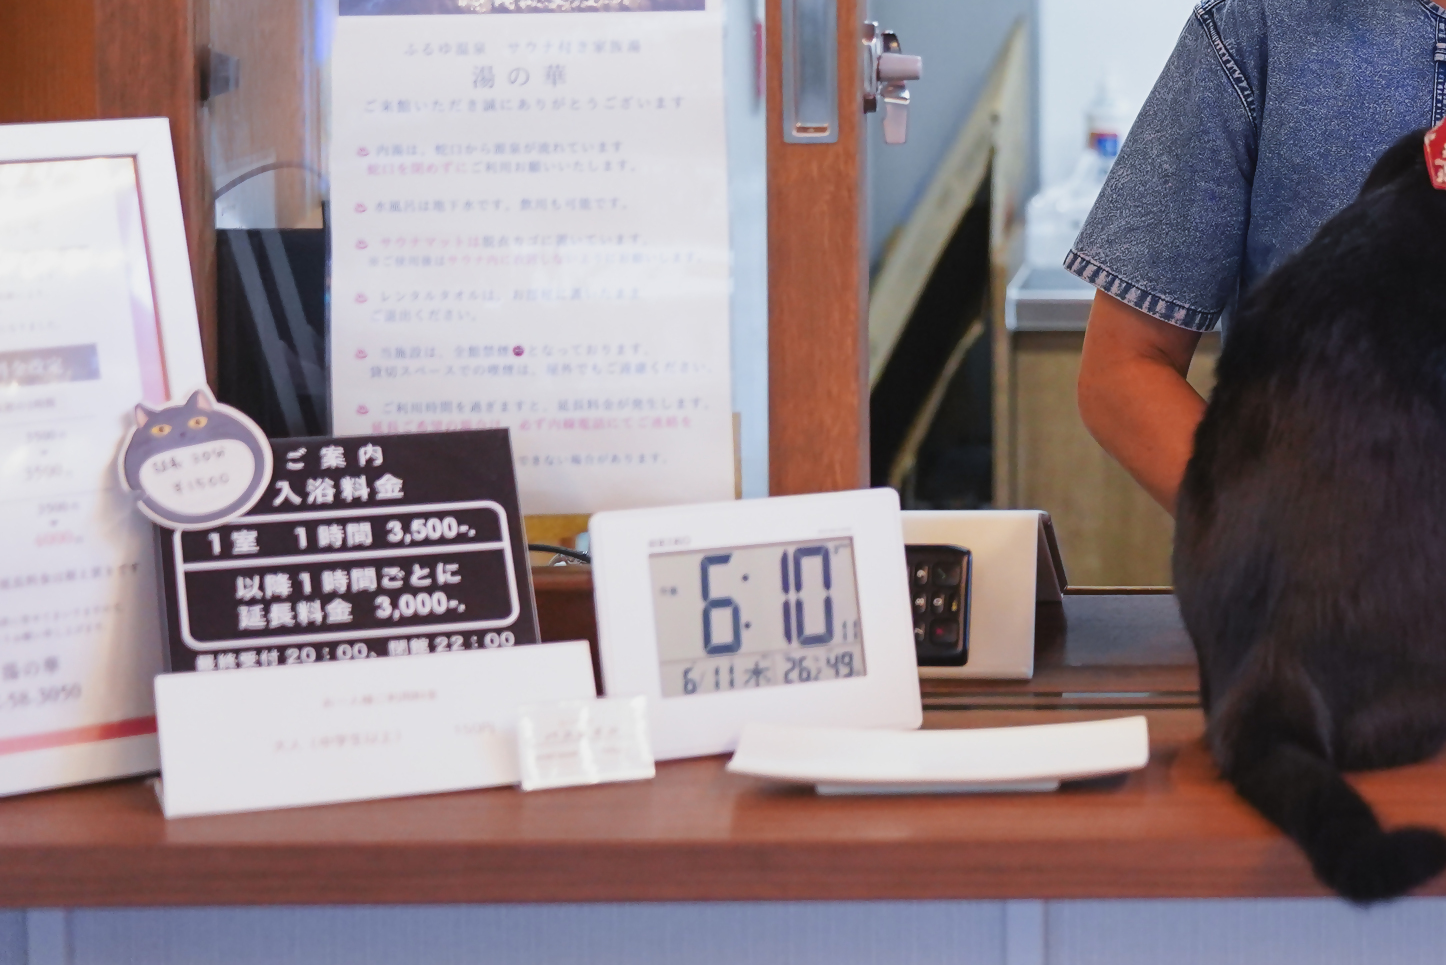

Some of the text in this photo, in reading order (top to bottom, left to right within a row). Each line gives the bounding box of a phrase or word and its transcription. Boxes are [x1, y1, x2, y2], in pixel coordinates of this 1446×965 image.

[471, 63, 567, 89] 湯の華
[286, 442, 384, 471] ご案内
[272, 473, 404, 507] 入浴料金
[235, 562, 462, 602] 以降1時間ごとに
[237, 598, 353, 632] 延長料金
